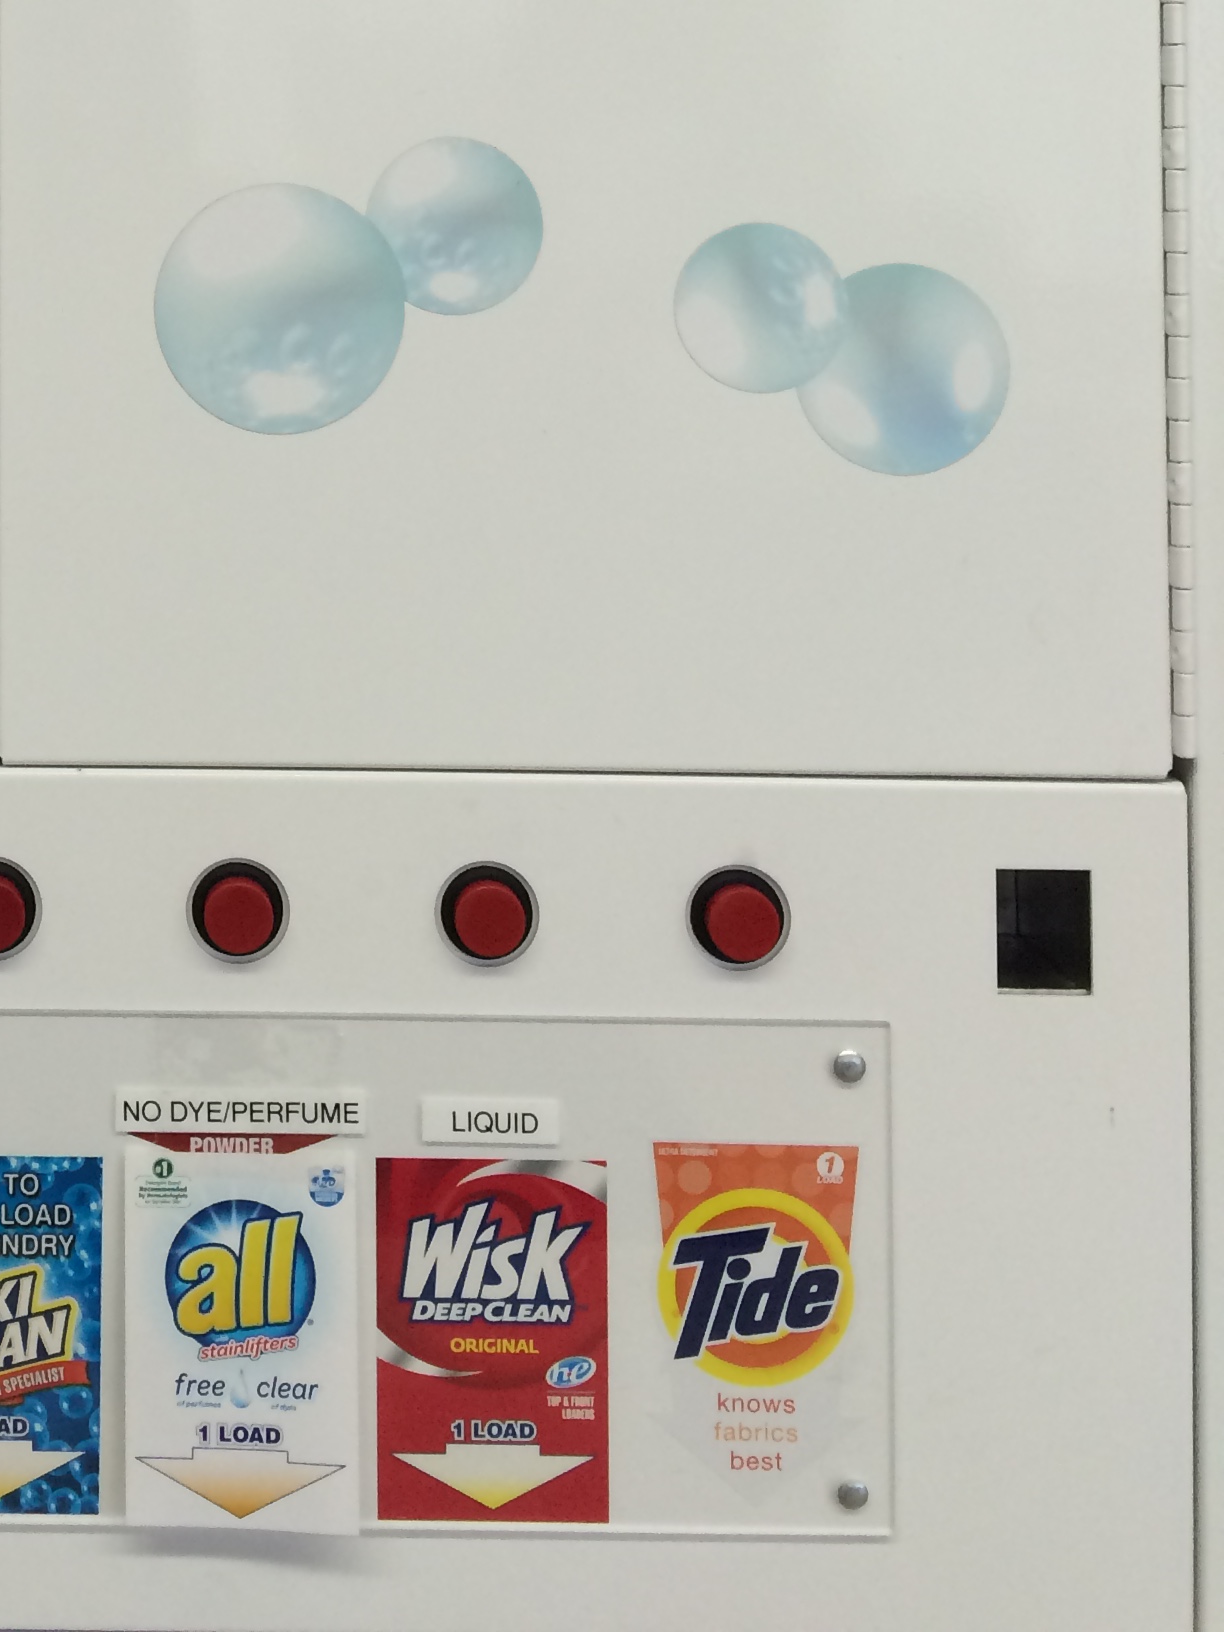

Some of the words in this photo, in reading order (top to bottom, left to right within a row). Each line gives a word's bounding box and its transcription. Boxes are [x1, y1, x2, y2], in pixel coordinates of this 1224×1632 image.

[123, 1100, 162, 1122] NO
[170, 1100, 359, 1124] DYE/PERFUME
[451, 1110, 539, 1136] LIQUID
[189, 1136, 275, 1154] POWDER
[824, 1155, 836, 1174] 1
[3, 1173, 40, 1196] TO
[816, 1175, 844, 1184] LOAD
[0, 1203, 72, 1226] LOAD
[403, 1199, 588, 1301] Wisk
[177, 1214, 302, 1337] all
[673, 1225, 842, 1360] Tide
[412, 1300, 484, 1322] DEEP
[484, 1301, 572, 1322] CLEAN
[200, 1336, 297, 1359] stainlifters
[450, 1337, 540, 1354] ORIGINAL
[2, 1366, 66, 1394] SPECIALIST
[175, 1372, 226, 1397] free
[256, 1375, 319, 1400] clear
[717, 1392, 796, 1414] knows
[198, 1424, 208, 1443] 1
[218, 1424, 282, 1445] LOAD
[452, 1421, 463, 1440] 1
[472, 1421, 536, 1441] LOAD
[714, 1421, 798, 1443] fabrics
[730, 1450, 782, 1471] best
